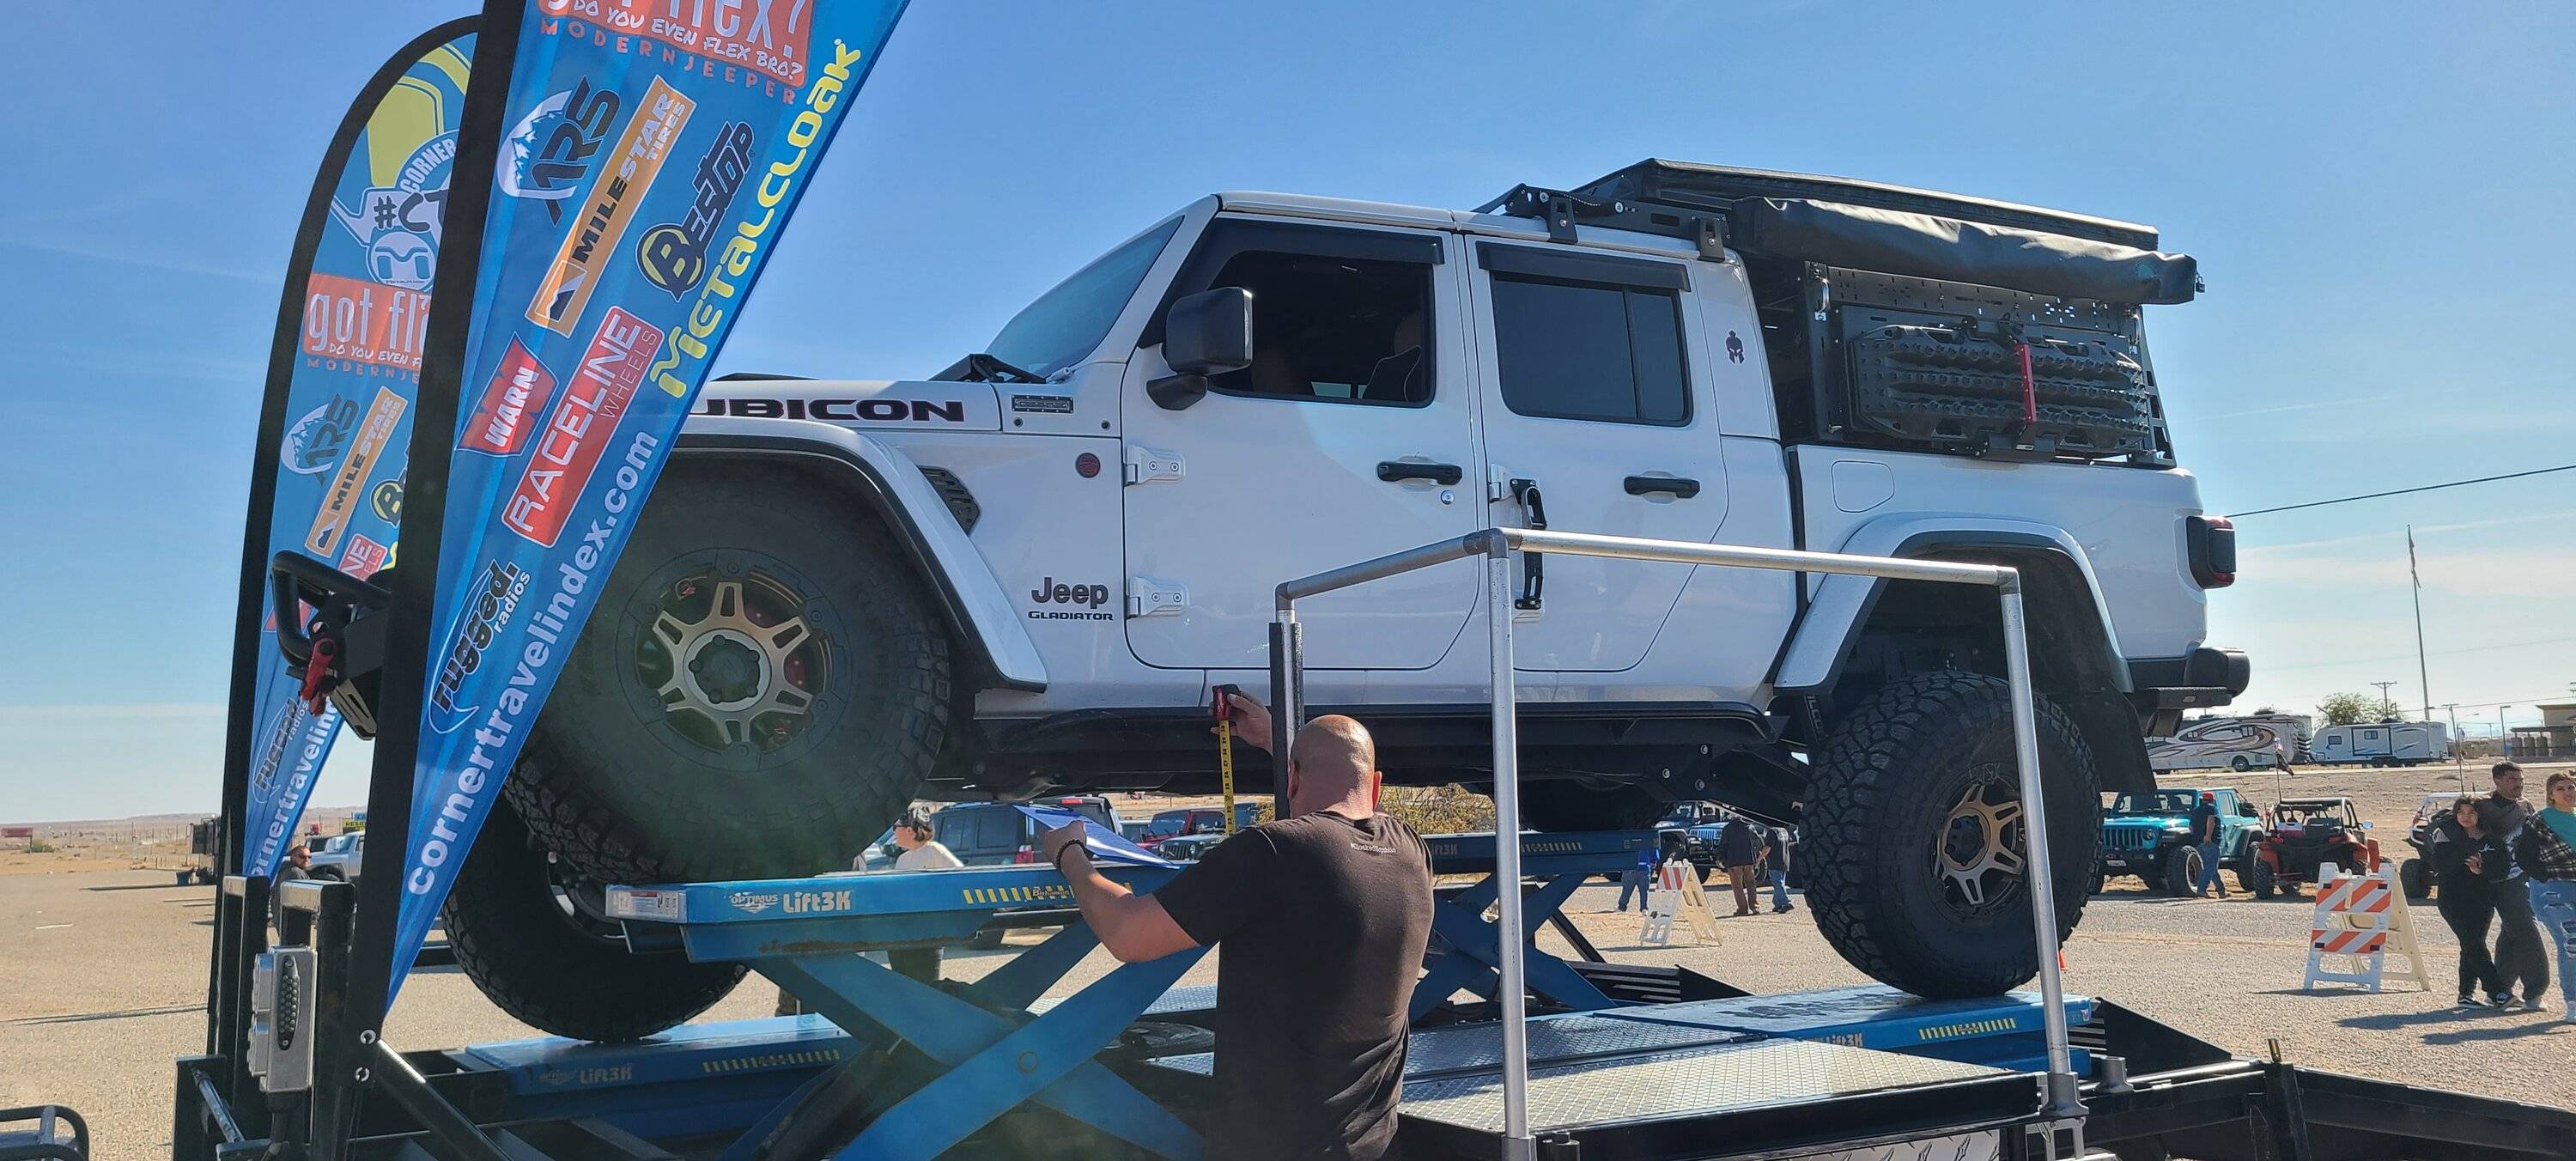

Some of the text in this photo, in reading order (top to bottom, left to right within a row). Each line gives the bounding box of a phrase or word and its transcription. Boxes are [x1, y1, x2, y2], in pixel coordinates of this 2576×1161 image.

[540, 19, 796, 105] MODERNJEEPER
[574, 0, 598, 16] DO
[607, 7, 644, 29] YOU
[652, 18, 697, 46] EVEN
[703, 37, 750, 61] FLEX
[756, 51, 803, 80] BRO?
[646, 102, 685, 161] TIRES
[399, 138, 456, 194] CORNER
[572, 92, 675, 264] MILESTAR
[374, 190, 448, 231] #CT
[309, 289, 373, 351] got
[307, 358, 420, 385] MODERNJE
[329, 343, 345, 355] DO
[350, 345, 373, 360] YOU
[378, 350, 409, 365] EVEN
[600, 331, 657, 418] WHEELS
[484, 366, 539, 447] WARN
[509, 313, 641, 533] RACELINE
[688, 398, 964, 422] UBICON
[493, 571, 531, 634] radios
[1028, 611, 1114, 621] GLADIATOR
[1031, 577, 1109, 609] Jeep
[408, 430, 659, 895] cornertravelindex.com
[288, 701, 309, 740] radios
[731, 891, 852, 913] OPTIMUS Lift3K
